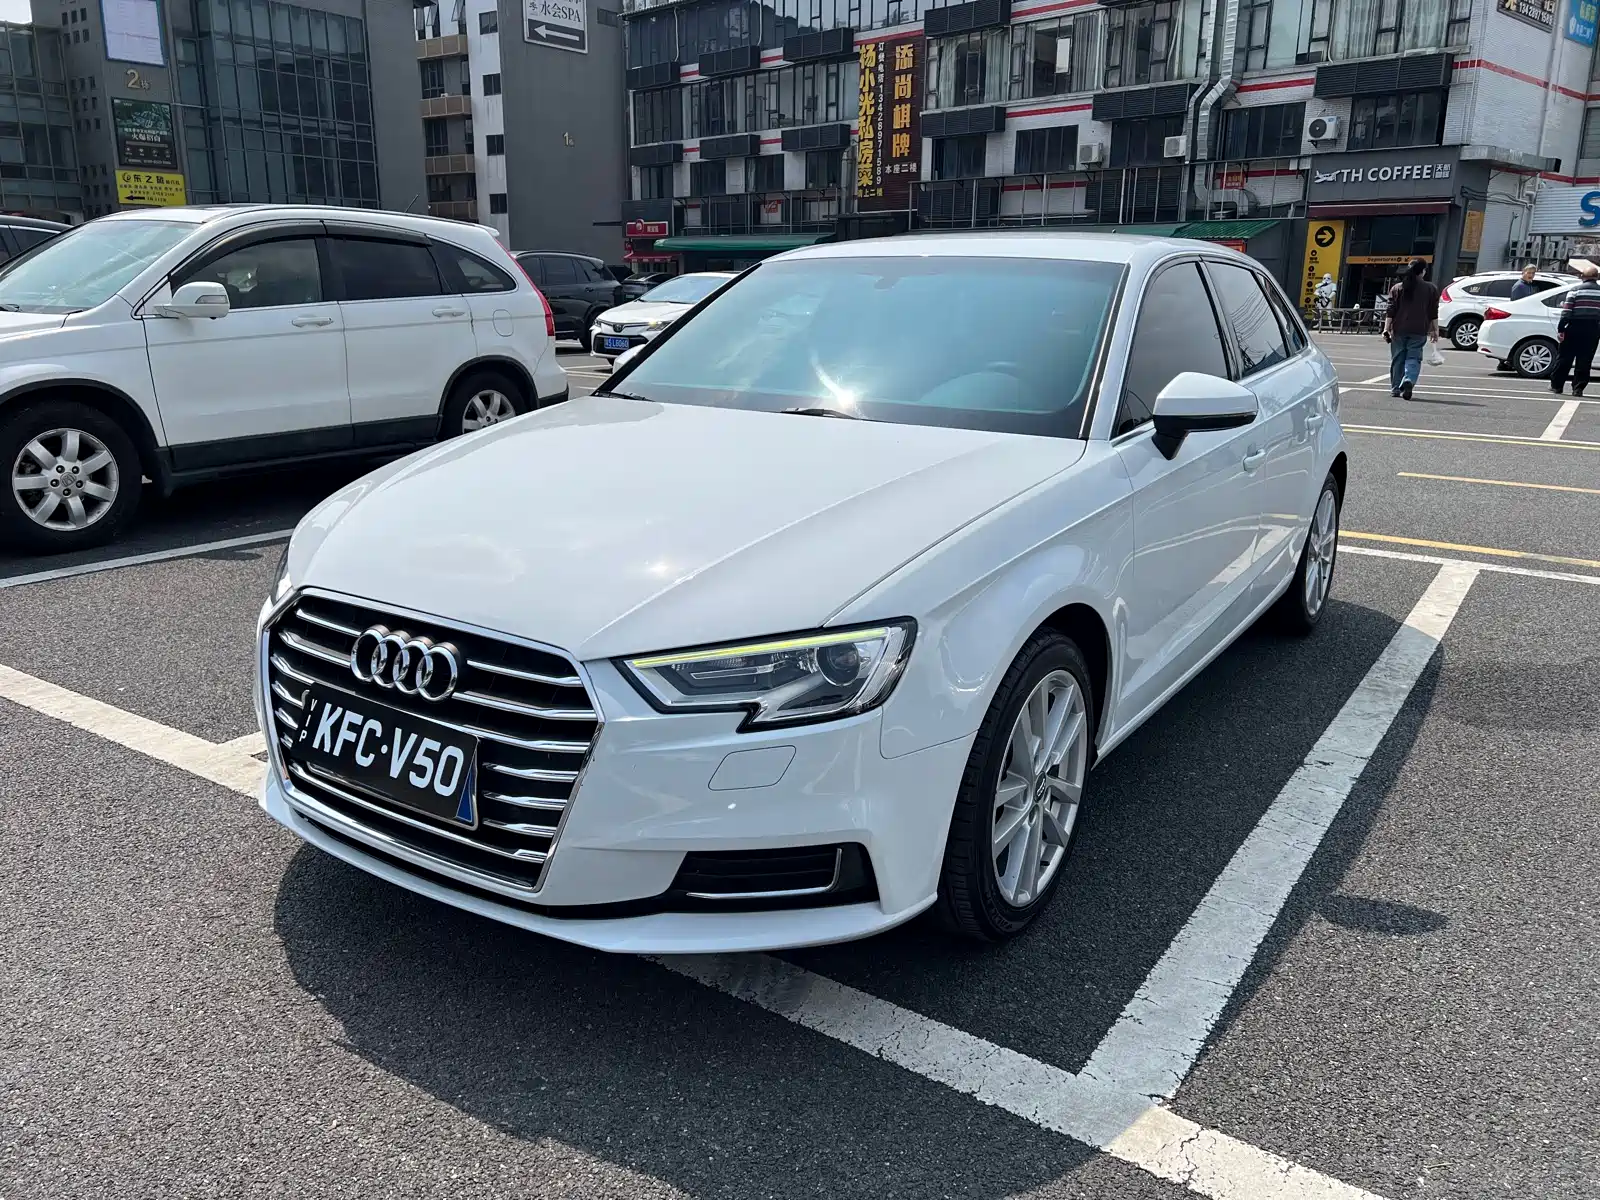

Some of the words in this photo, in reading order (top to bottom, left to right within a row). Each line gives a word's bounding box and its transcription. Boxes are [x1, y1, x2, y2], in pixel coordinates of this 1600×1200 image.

[858, 44, 876, 187] 杨小光私房菜
[892, 44, 914, 158] 添尚棋牌
[884, 162, 917, 174] 本座二楼
[1340, 168, 1363, 182] TH
[1367, 164, 1432, 181] COFFEE
[1578, 191, 1600, 227] S
[299, 698, 317, 742] VIP
[312, 702, 464, 797] KFC·V50
